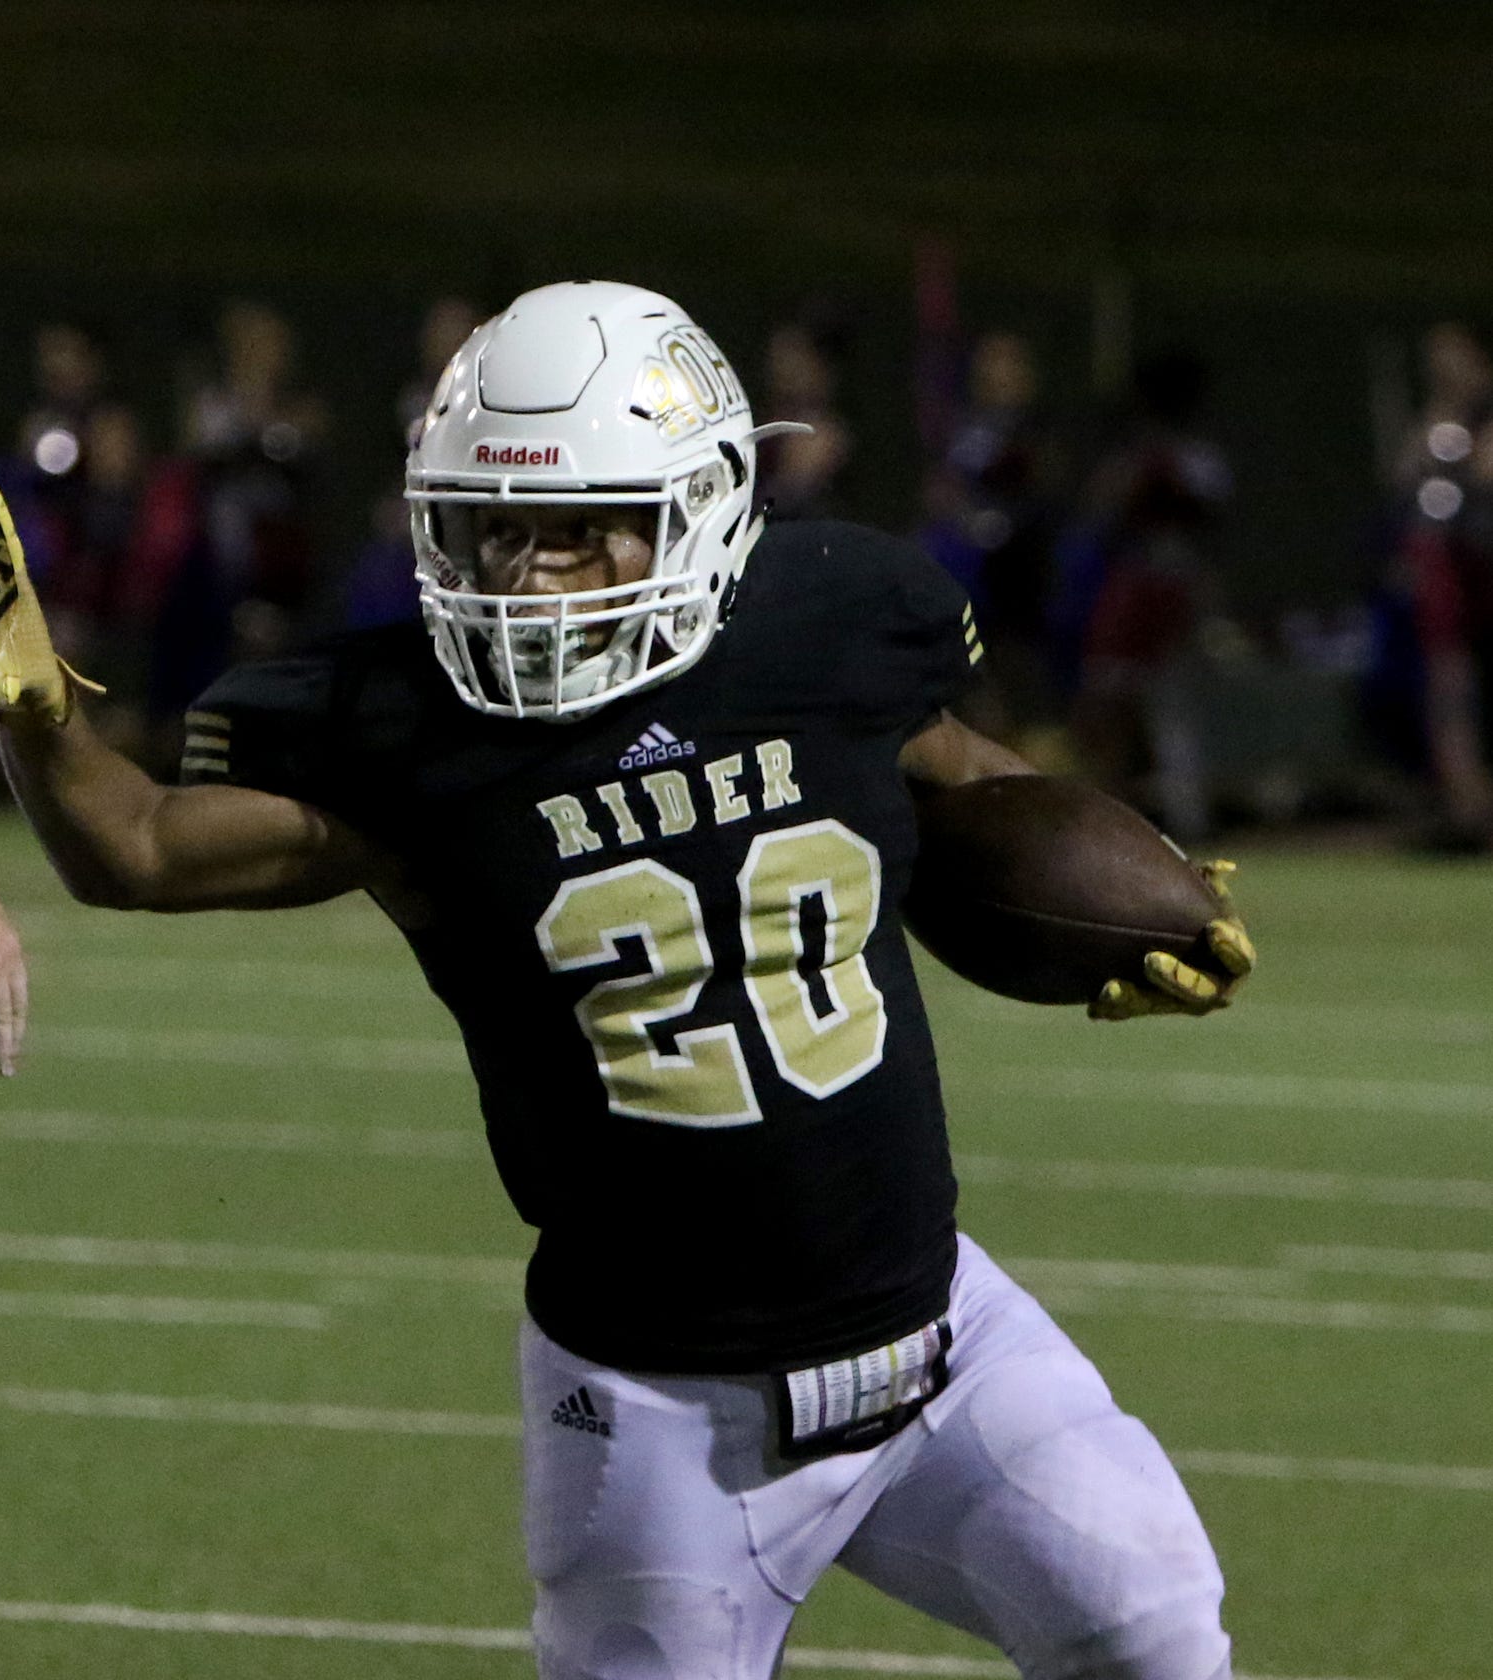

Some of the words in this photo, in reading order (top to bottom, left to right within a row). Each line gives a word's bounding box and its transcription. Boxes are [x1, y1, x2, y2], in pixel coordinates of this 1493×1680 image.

[475, 444, 560, 466] Riddell
[618, 738, 697, 771] adidas
[536, 738, 803, 859] RIDER
[534, 818, 888, 1129] 20
[550, 1408, 612, 1438] adidas
